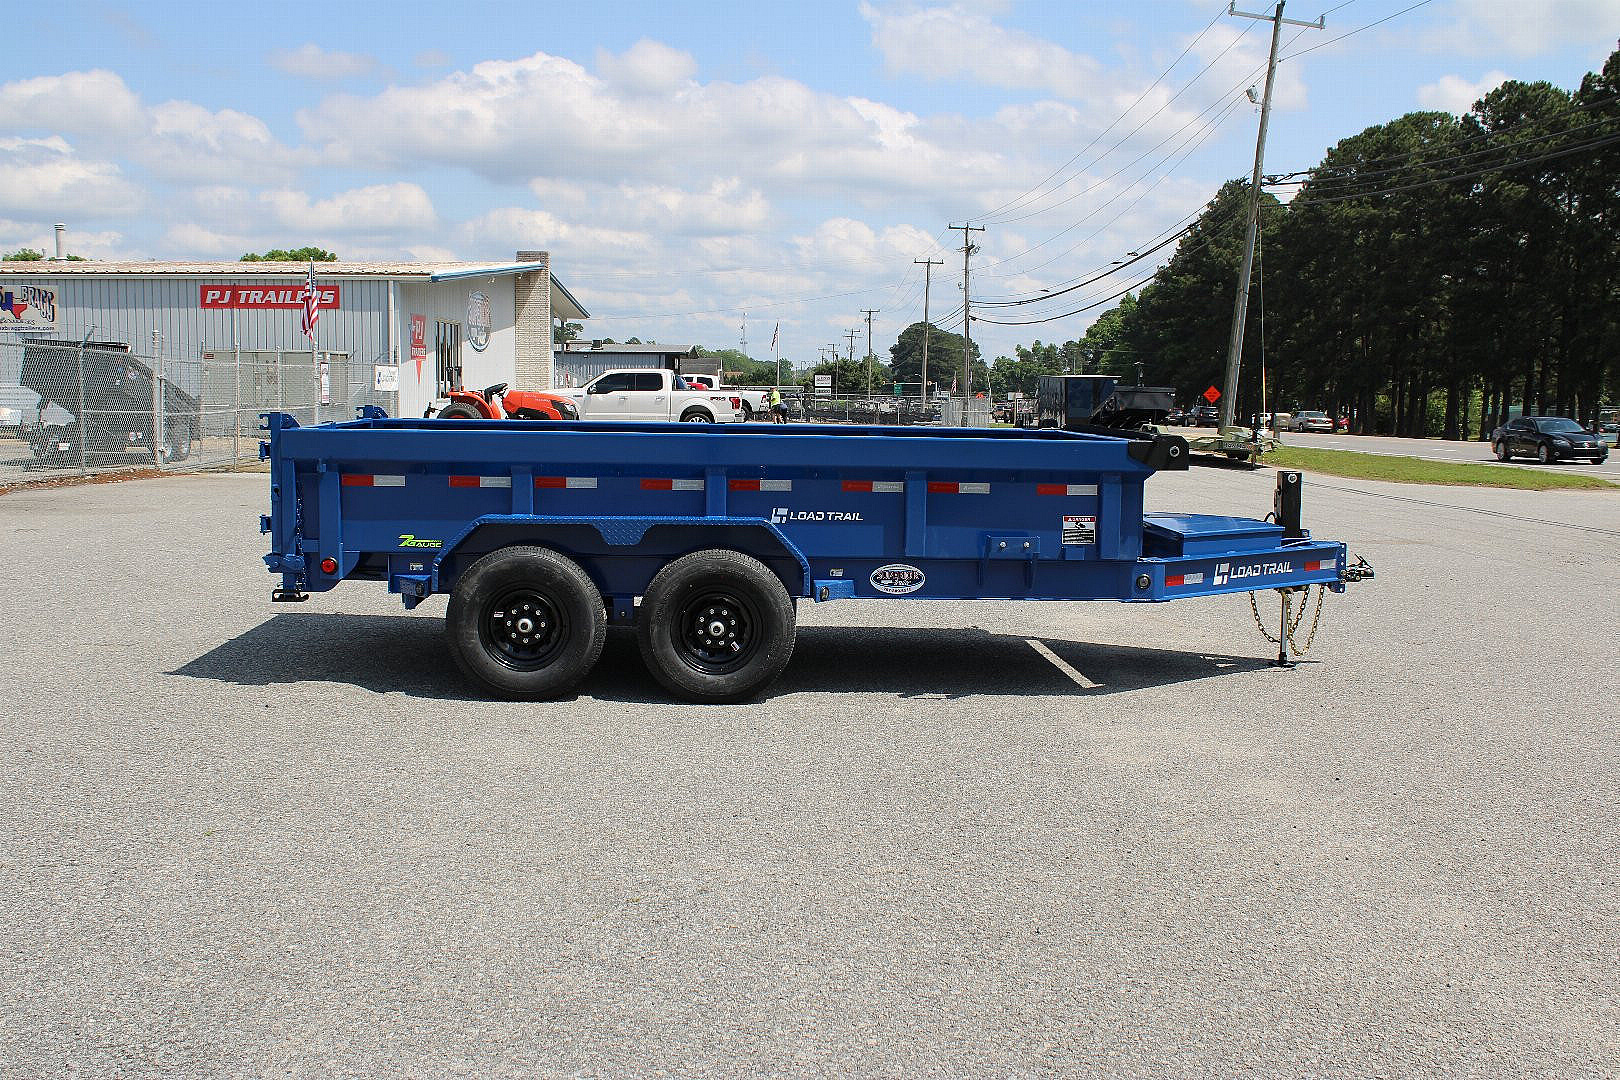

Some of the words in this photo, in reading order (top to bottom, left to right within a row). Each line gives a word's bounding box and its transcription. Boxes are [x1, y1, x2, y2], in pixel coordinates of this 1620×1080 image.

[21, 286, 54, 322] BRAGG
[205, 290, 232, 304] PJ
[790, 511, 825, 521] LOAD
[826, 511, 864, 521] TRAIL
[1230, 565, 1261, 578] LOAD
[1262, 562, 1292, 575] TRAIL
